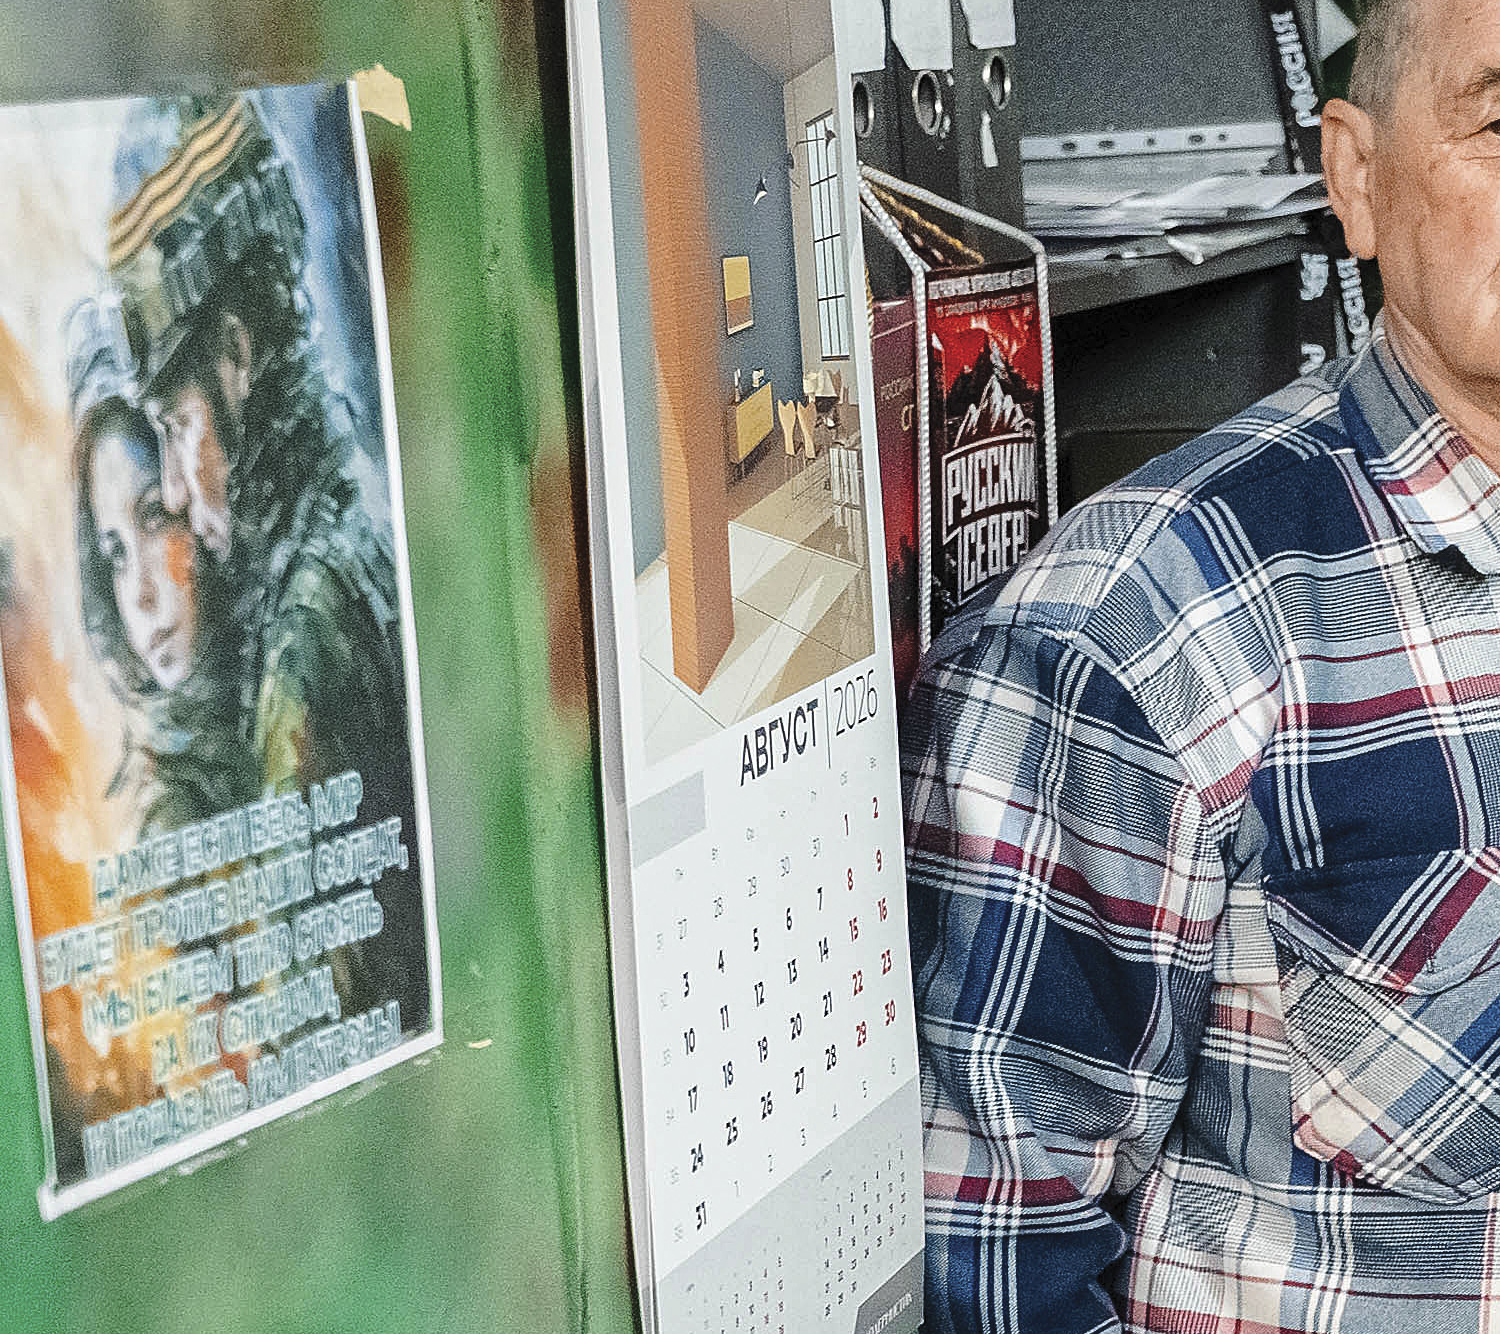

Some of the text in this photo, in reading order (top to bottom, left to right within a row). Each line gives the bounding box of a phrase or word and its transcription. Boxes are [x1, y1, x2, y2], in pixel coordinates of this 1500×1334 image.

[947, 443, 1037, 527] РУССКИЙ
[962, 511, 1027, 594] СЕВЕР
[741, 669, 878, 787] АВГУСТ 2026
[309, 769, 364, 833] МИР
[844, 814, 849, 836] 1
[872, 796, 879, 819] 2
[292, 888, 385, 961] СТОЯТЬ
[683, 849, 882, 998] 3 4 5 6 7 8 9
[684, 897, 888, 1055] 10 11 12 13 14 15 16
[687, 949, 892, 1113] 17 18 19 20 21 22 23
[691, 999, 896, 1173] 24 25 26 27 28 29 30
[696, 1201, 707, 1231] 31
